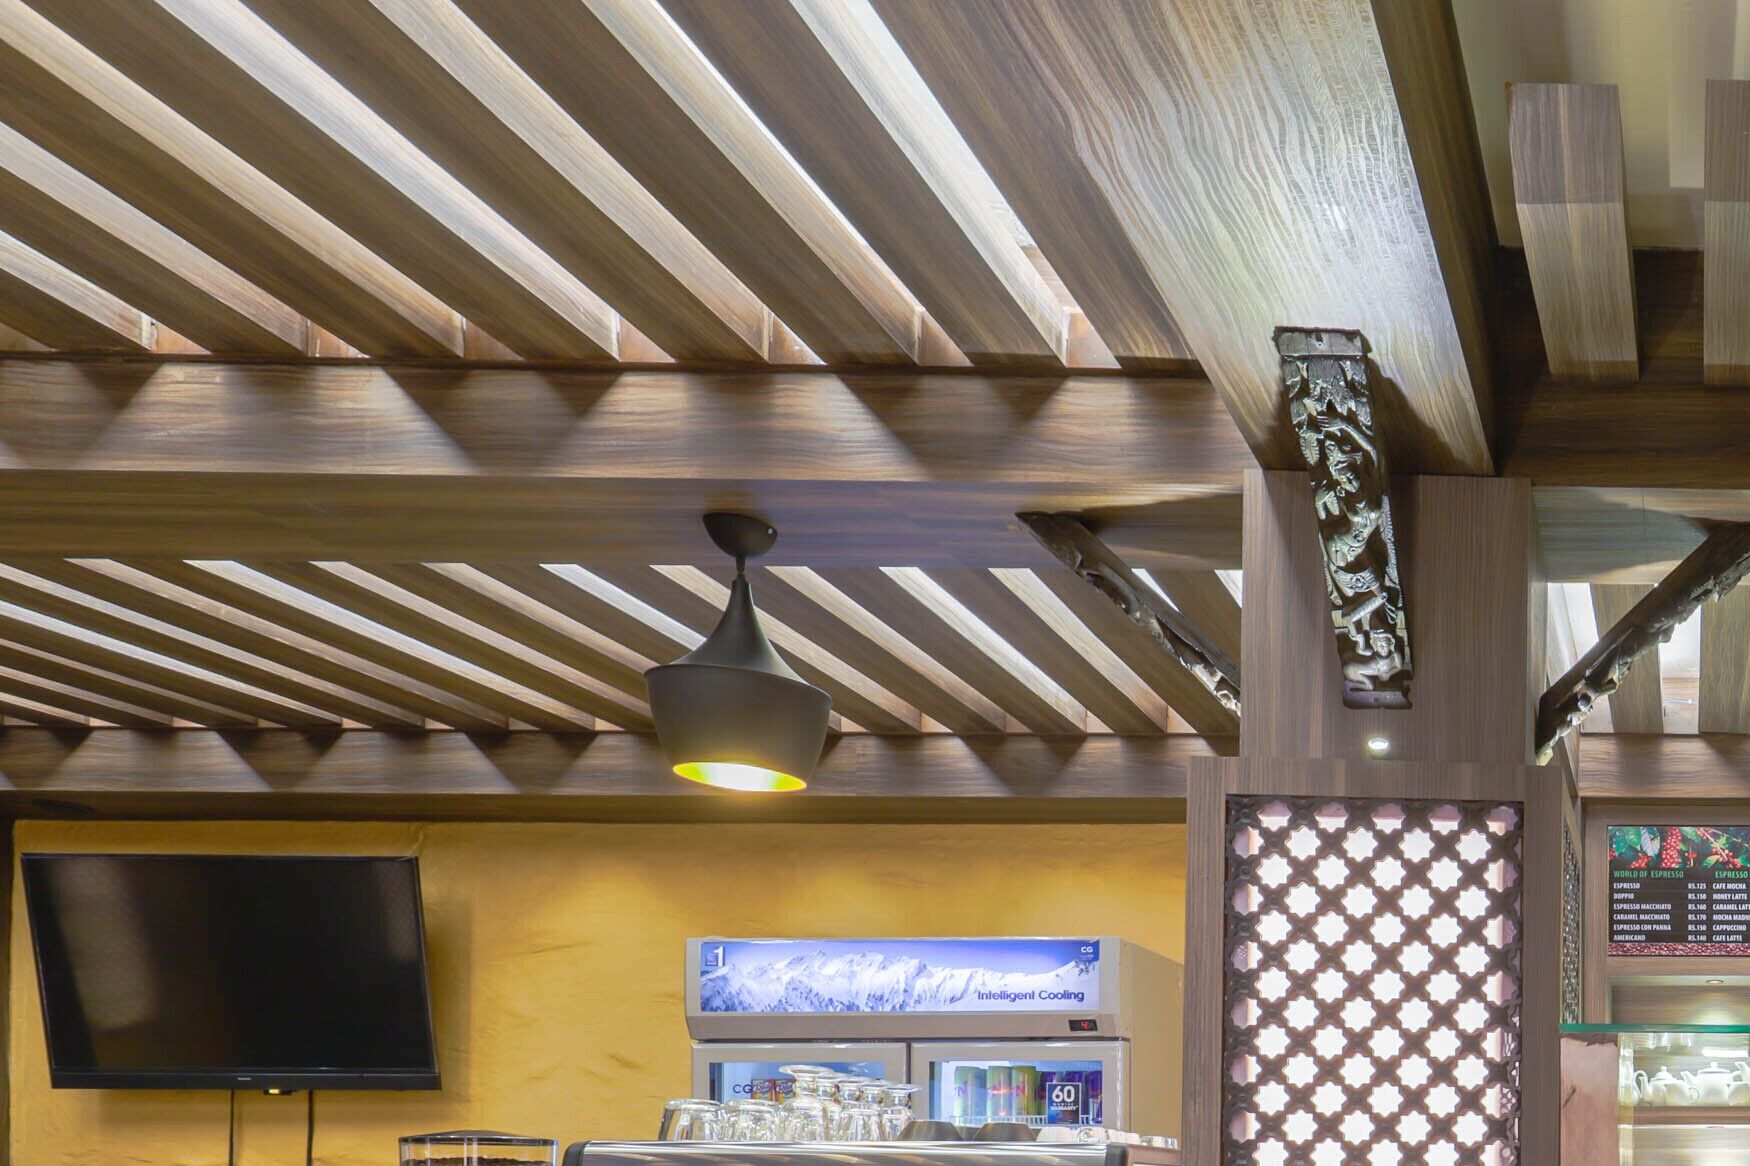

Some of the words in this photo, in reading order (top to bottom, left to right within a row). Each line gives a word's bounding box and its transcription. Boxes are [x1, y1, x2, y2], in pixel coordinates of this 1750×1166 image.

[978, 990, 1034, 1002] Intelligent
[1038, 990, 1085, 1002] Cooling
[1052, 1086, 1075, 1102] 60
